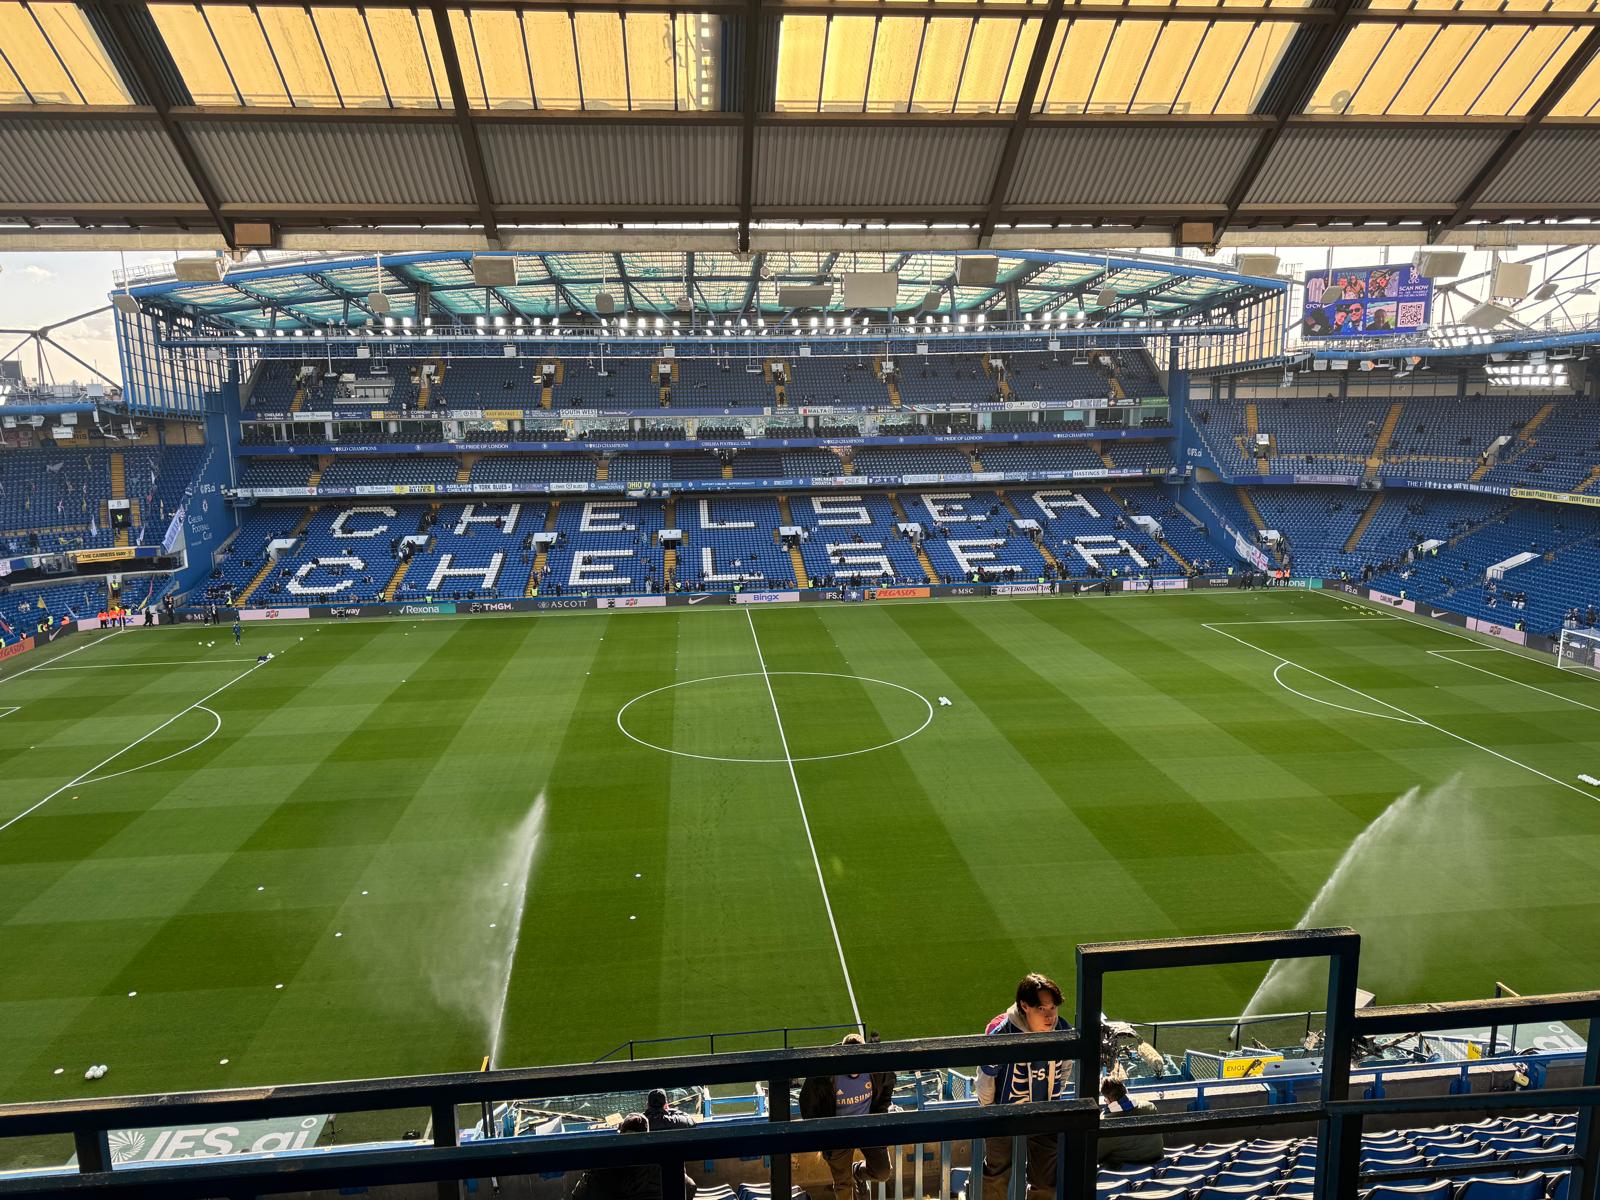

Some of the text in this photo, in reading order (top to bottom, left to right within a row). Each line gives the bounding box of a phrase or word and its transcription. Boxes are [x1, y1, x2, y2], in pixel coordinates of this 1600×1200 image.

[878, 589, 917, 598] PEGASUS
[1345, 585, 1358, 595] IFS.ai
[331, 607, 360, 615] bway
[406, 605, 439, 613] Rexona
[0, 642, 25, 656] EGASUS
[836, 1091, 873, 1105] SAMSUN
